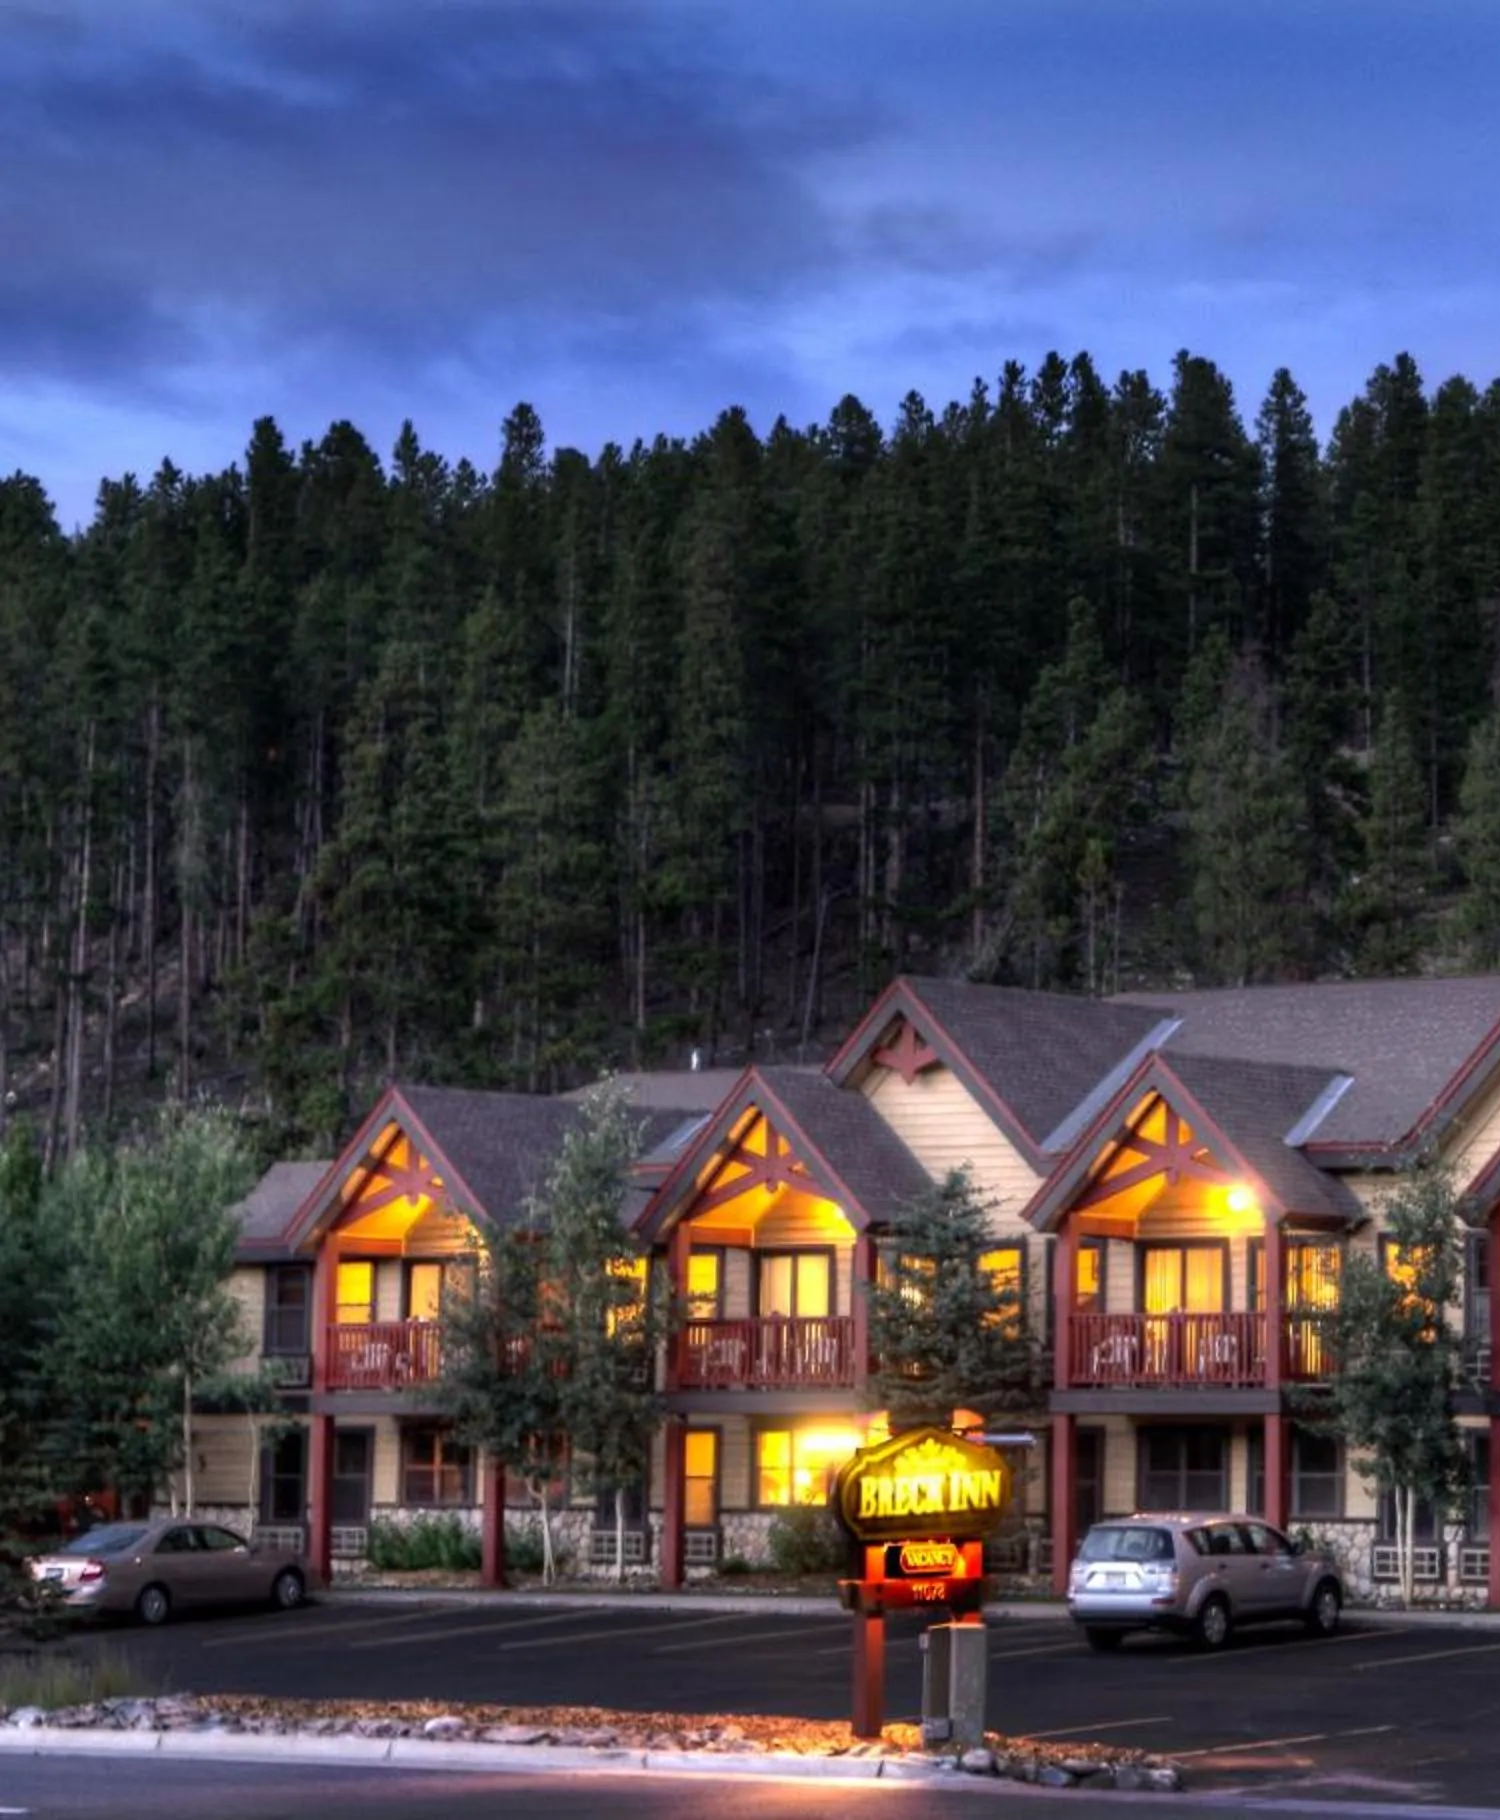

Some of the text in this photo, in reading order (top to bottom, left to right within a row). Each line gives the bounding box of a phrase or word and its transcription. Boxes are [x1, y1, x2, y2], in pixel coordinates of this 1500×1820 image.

[859, 1470, 1002, 1519] BRECK INN
[904, 1548, 954, 1567] VACANCY
